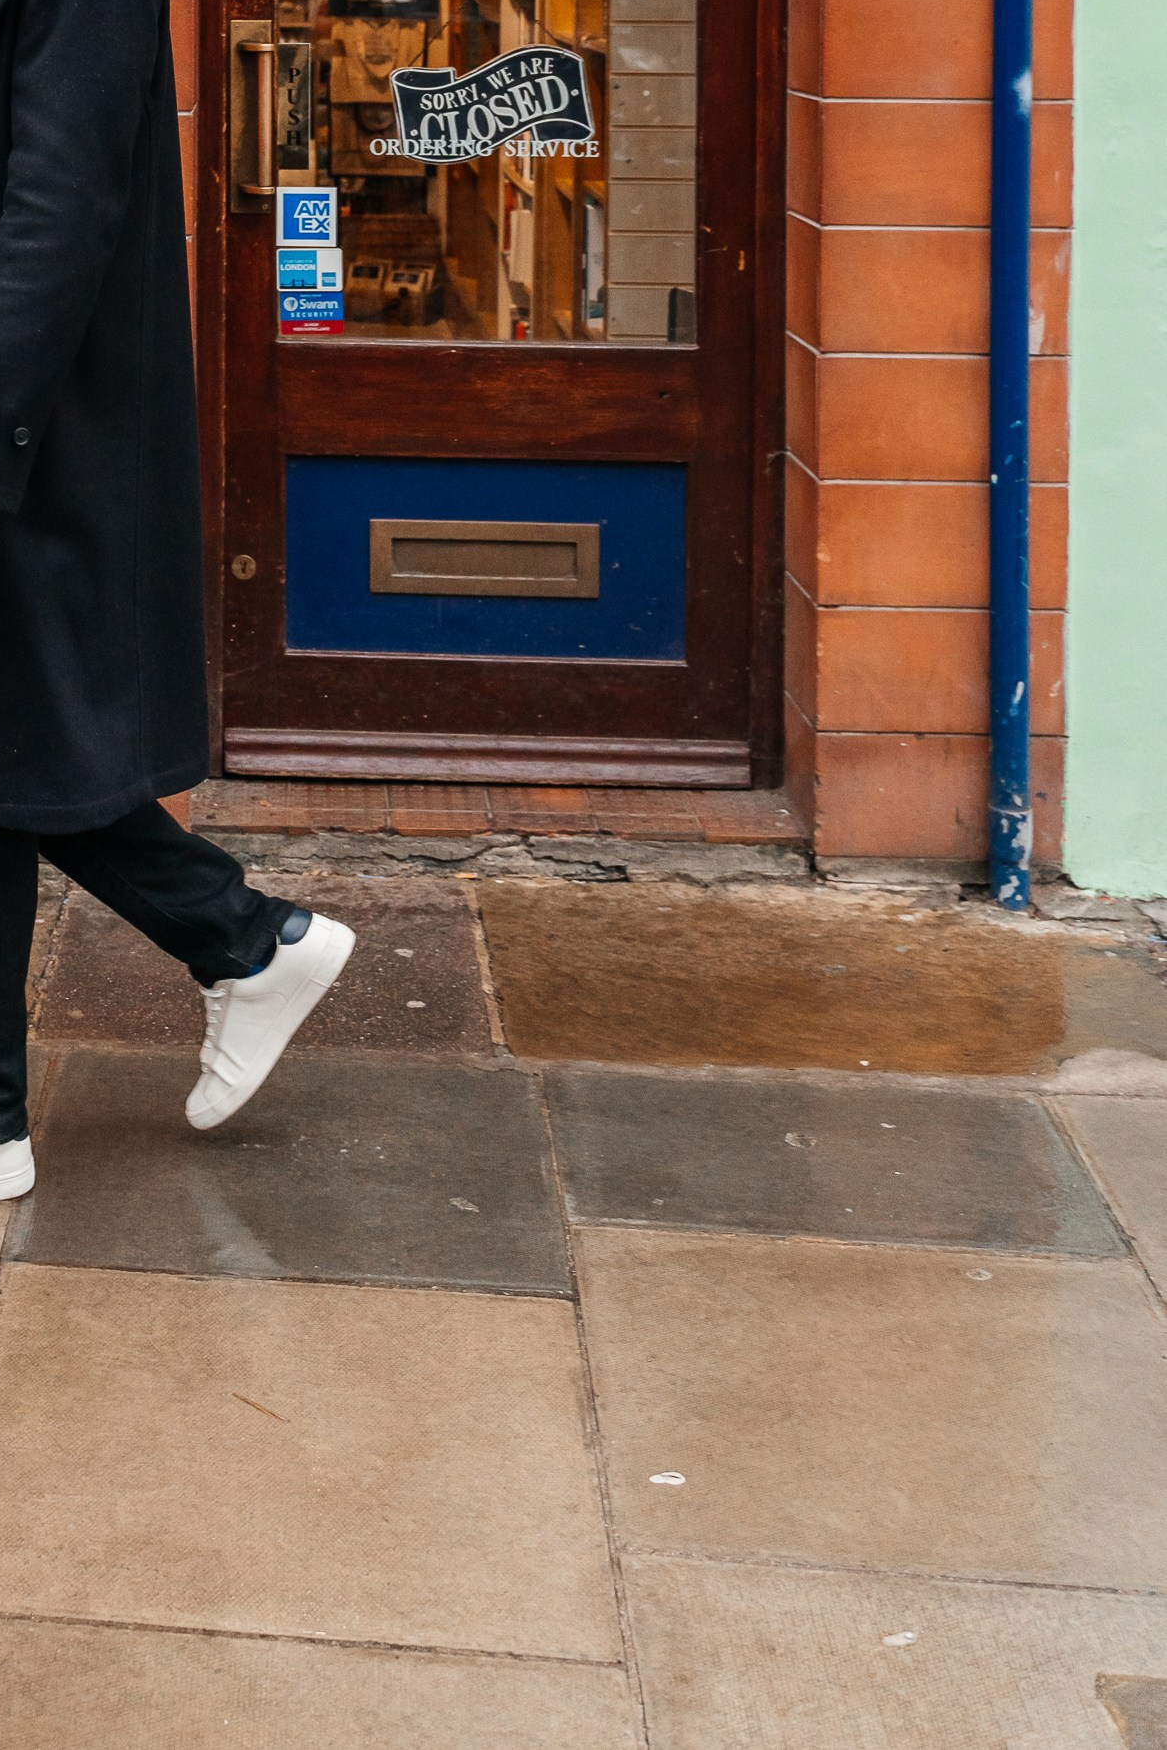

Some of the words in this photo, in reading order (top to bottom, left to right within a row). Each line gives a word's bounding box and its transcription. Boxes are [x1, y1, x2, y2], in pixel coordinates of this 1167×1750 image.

[420, 84, 487, 110] SORRY,
[487, 67, 514, 90] WE
[520, 57, 554, 78] ARE
[287, 67, 301, 146] PUSH
[420, 76, 570, 148] CLOSED
[370, 139, 493, 157] ORDERING
[505, 139, 600, 158] SERVICE
[296, 201, 330, 217] AM
[299, 298, 338, 310] Swann
